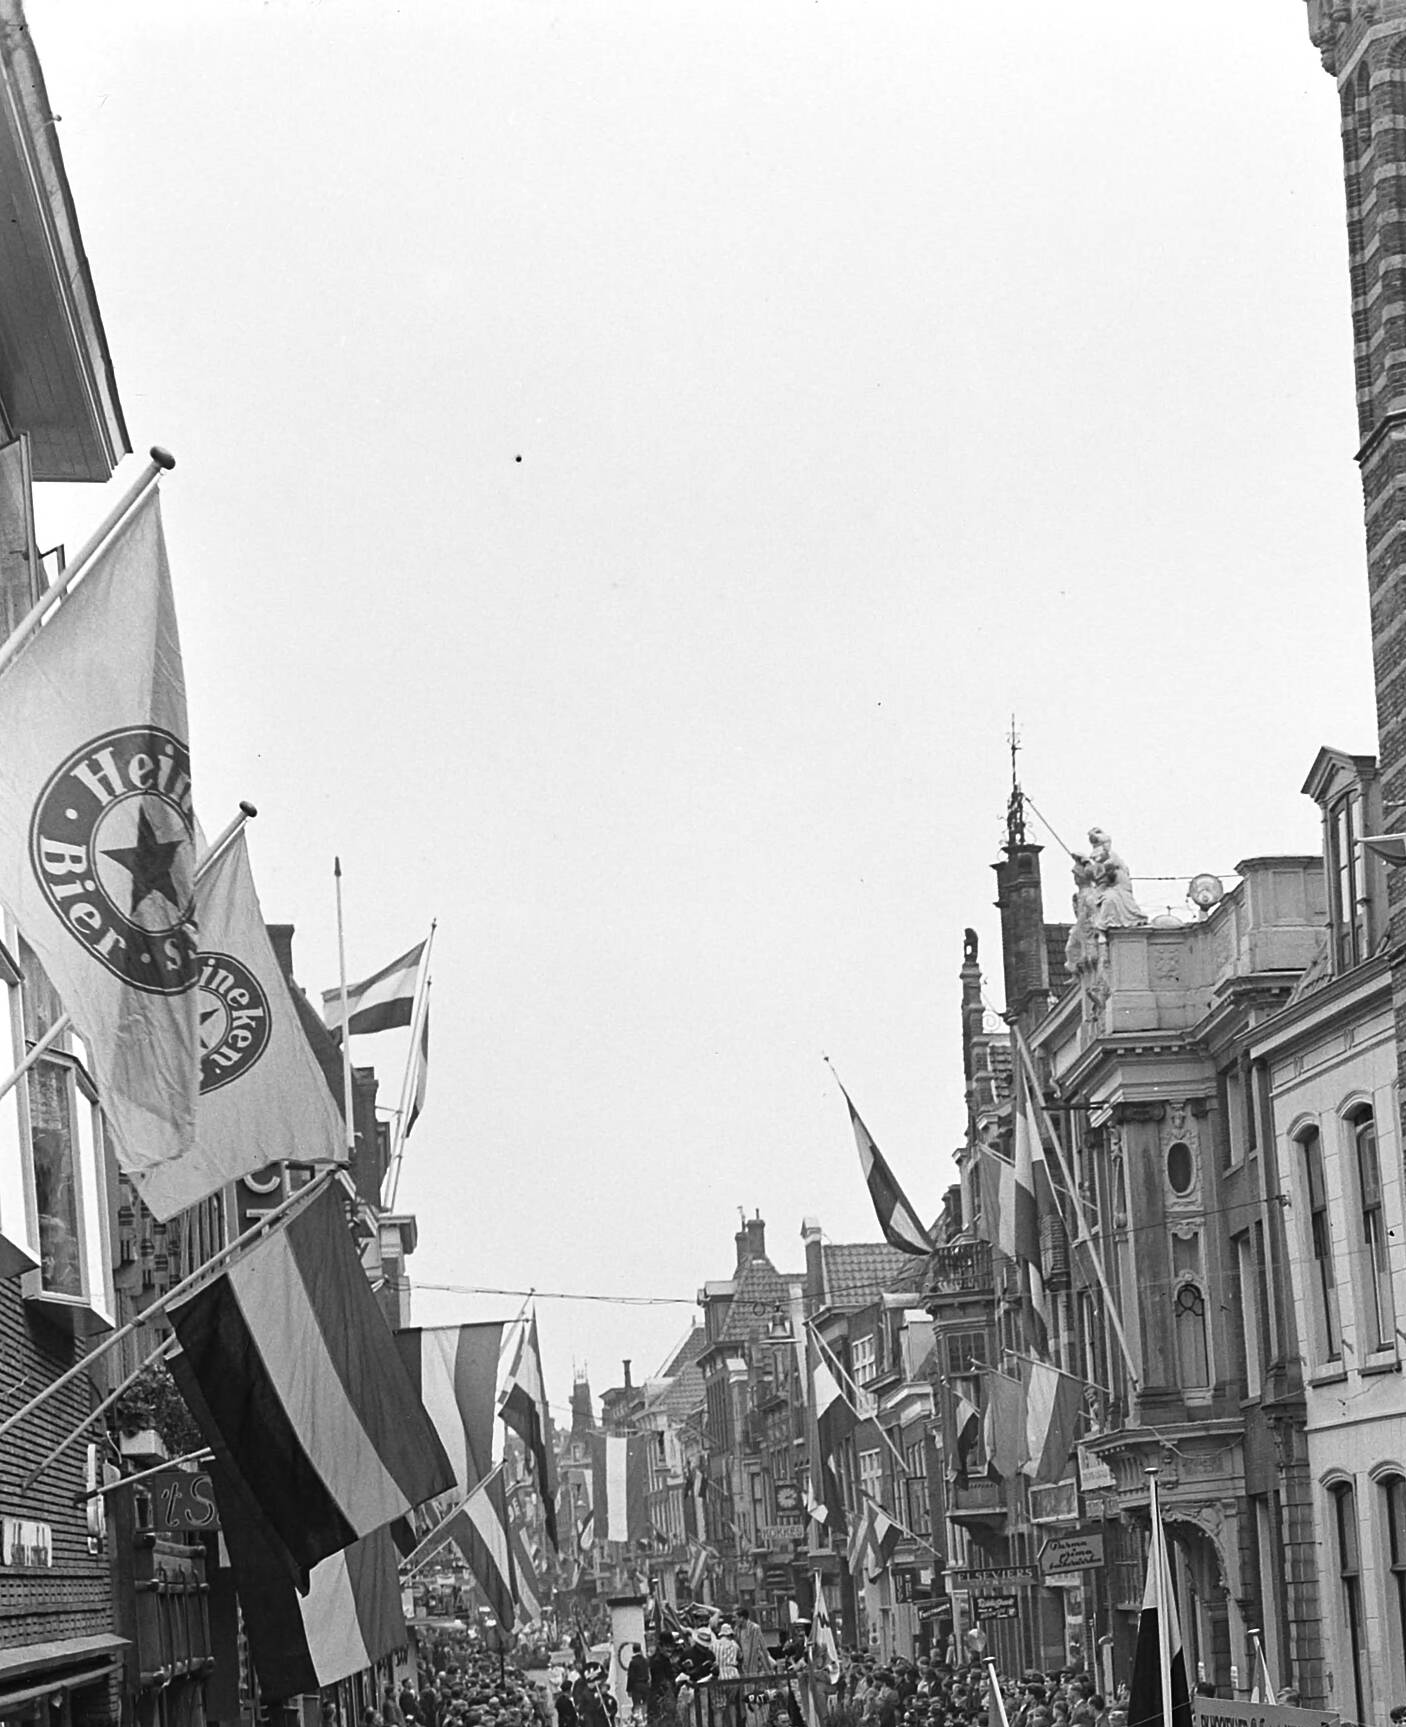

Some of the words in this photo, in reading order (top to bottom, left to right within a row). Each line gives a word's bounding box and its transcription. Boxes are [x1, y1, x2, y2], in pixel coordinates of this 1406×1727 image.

[40, 834, 127, 958] Bier
[200, 958, 264, 1074] ineken'
[185, 1474, 215, 1526] S
[957, 1567, 1033, 1582] ELSEVIERS
